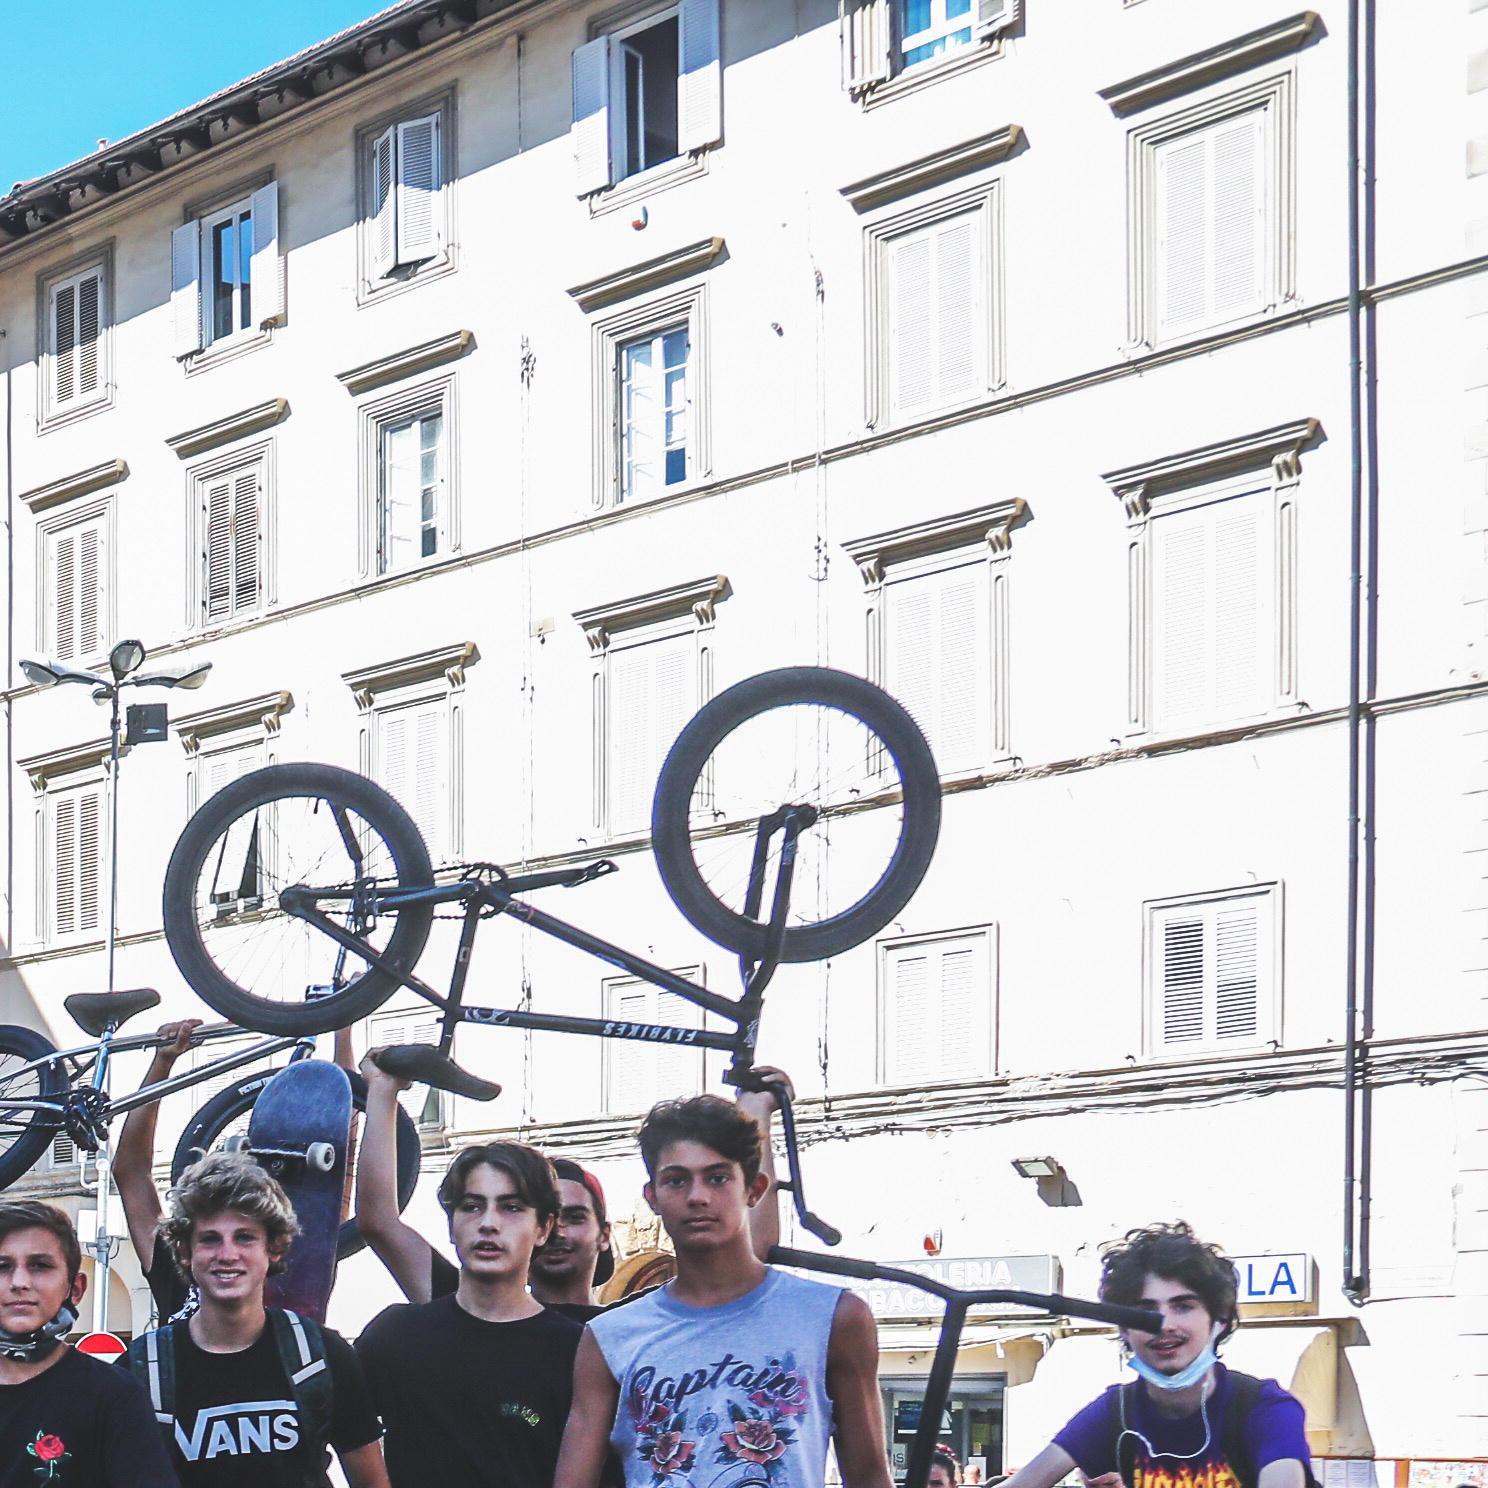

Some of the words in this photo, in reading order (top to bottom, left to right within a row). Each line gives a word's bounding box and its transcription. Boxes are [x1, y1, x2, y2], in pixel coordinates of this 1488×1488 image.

[602, 1021, 698, 1043] FLYBIKES
[630, 1353, 802, 1414] Captain
[174, 1399, 299, 1462] VANS
